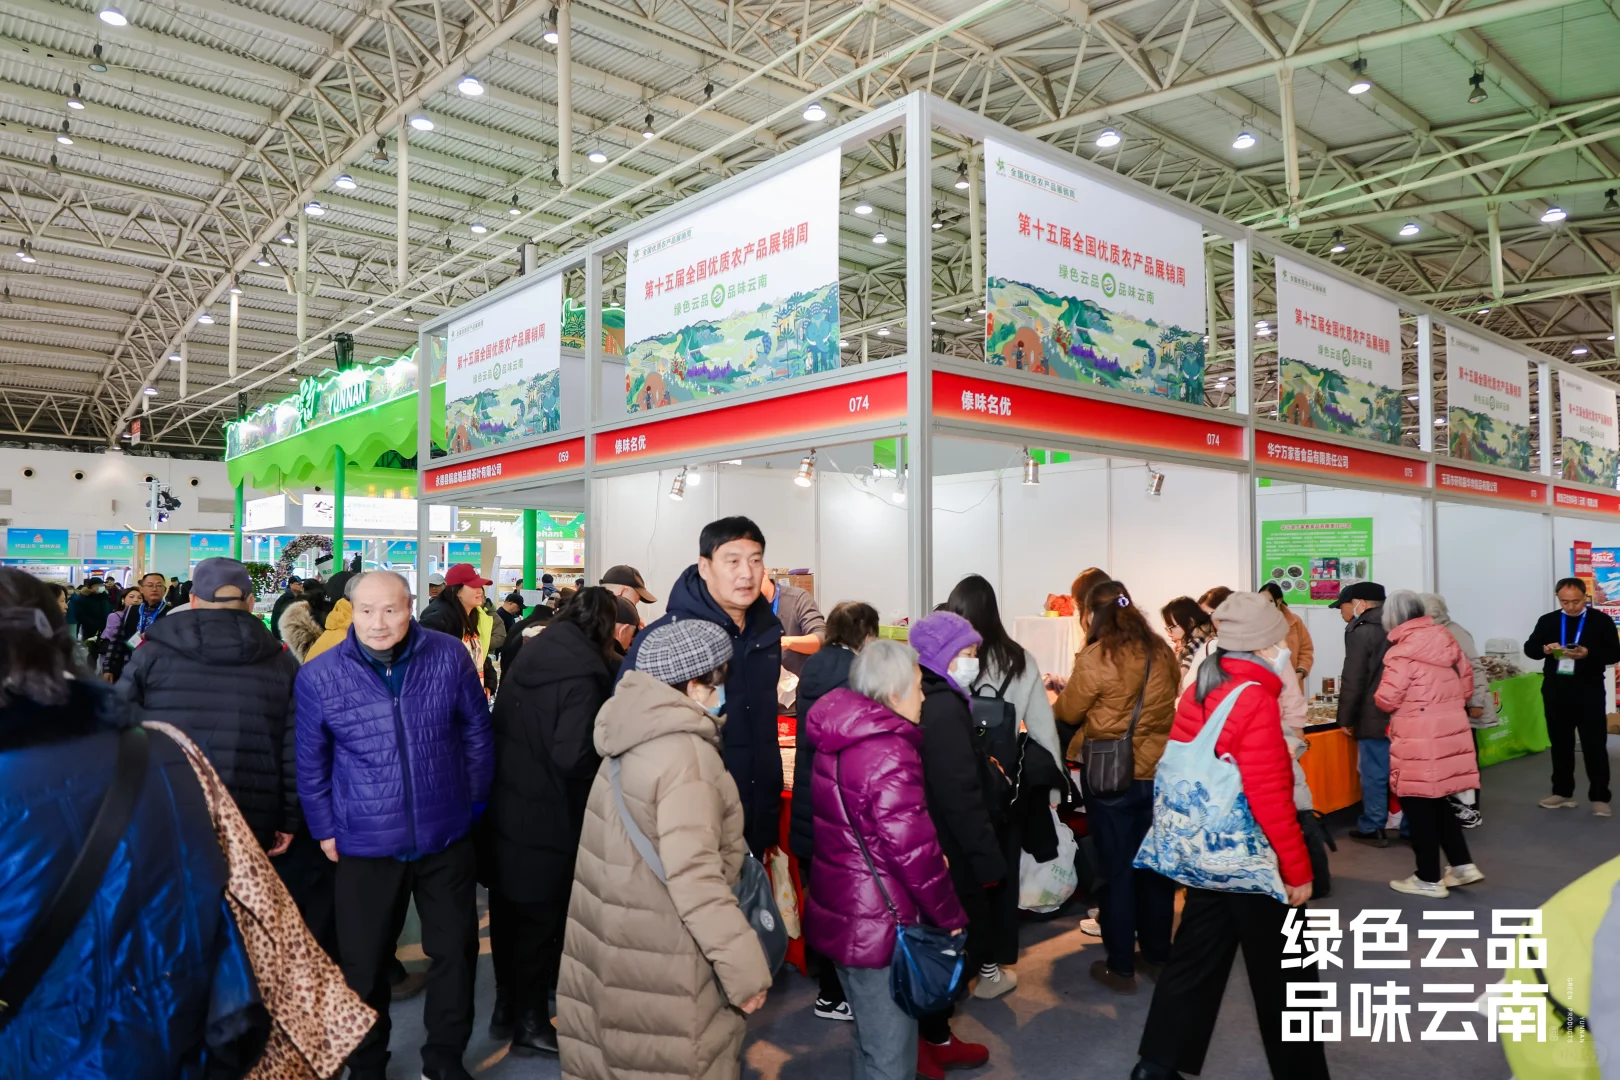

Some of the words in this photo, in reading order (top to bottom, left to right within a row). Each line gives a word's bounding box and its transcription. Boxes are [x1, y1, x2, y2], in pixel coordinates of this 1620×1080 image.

[644, 222, 808, 300] 第十五届全国优质农产品展销周
[1018, 212, 1187, 287] 第十五届全国优质农产品展销周
[673, 293, 709, 317] 绿色云品
[727, 274, 767, 299] 品味云南
[1058, 264, 1100, 288] 绿色云品
[1118, 282, 1155, 305] 品味云南
[457, 323, 546, 370] 第十五届全国优质农产品展销周
[1295, 308, 1390, 354] 第十五届全国优质农产品展销周
[501, 358, 524, 375] 品味云南
[328, 380, 367, 415] YUNNAN
[961, 389, 1012, 416] 傣味名优
[1207, 432, 1220, 446] 074
[614, 434, 647, 455] 傣味名优
[848, 394, 870, 412] 074
[1267, 442, 1349, 468] 华宁万家香食品有限责任公司
[536, 530, 564, 539] phant
